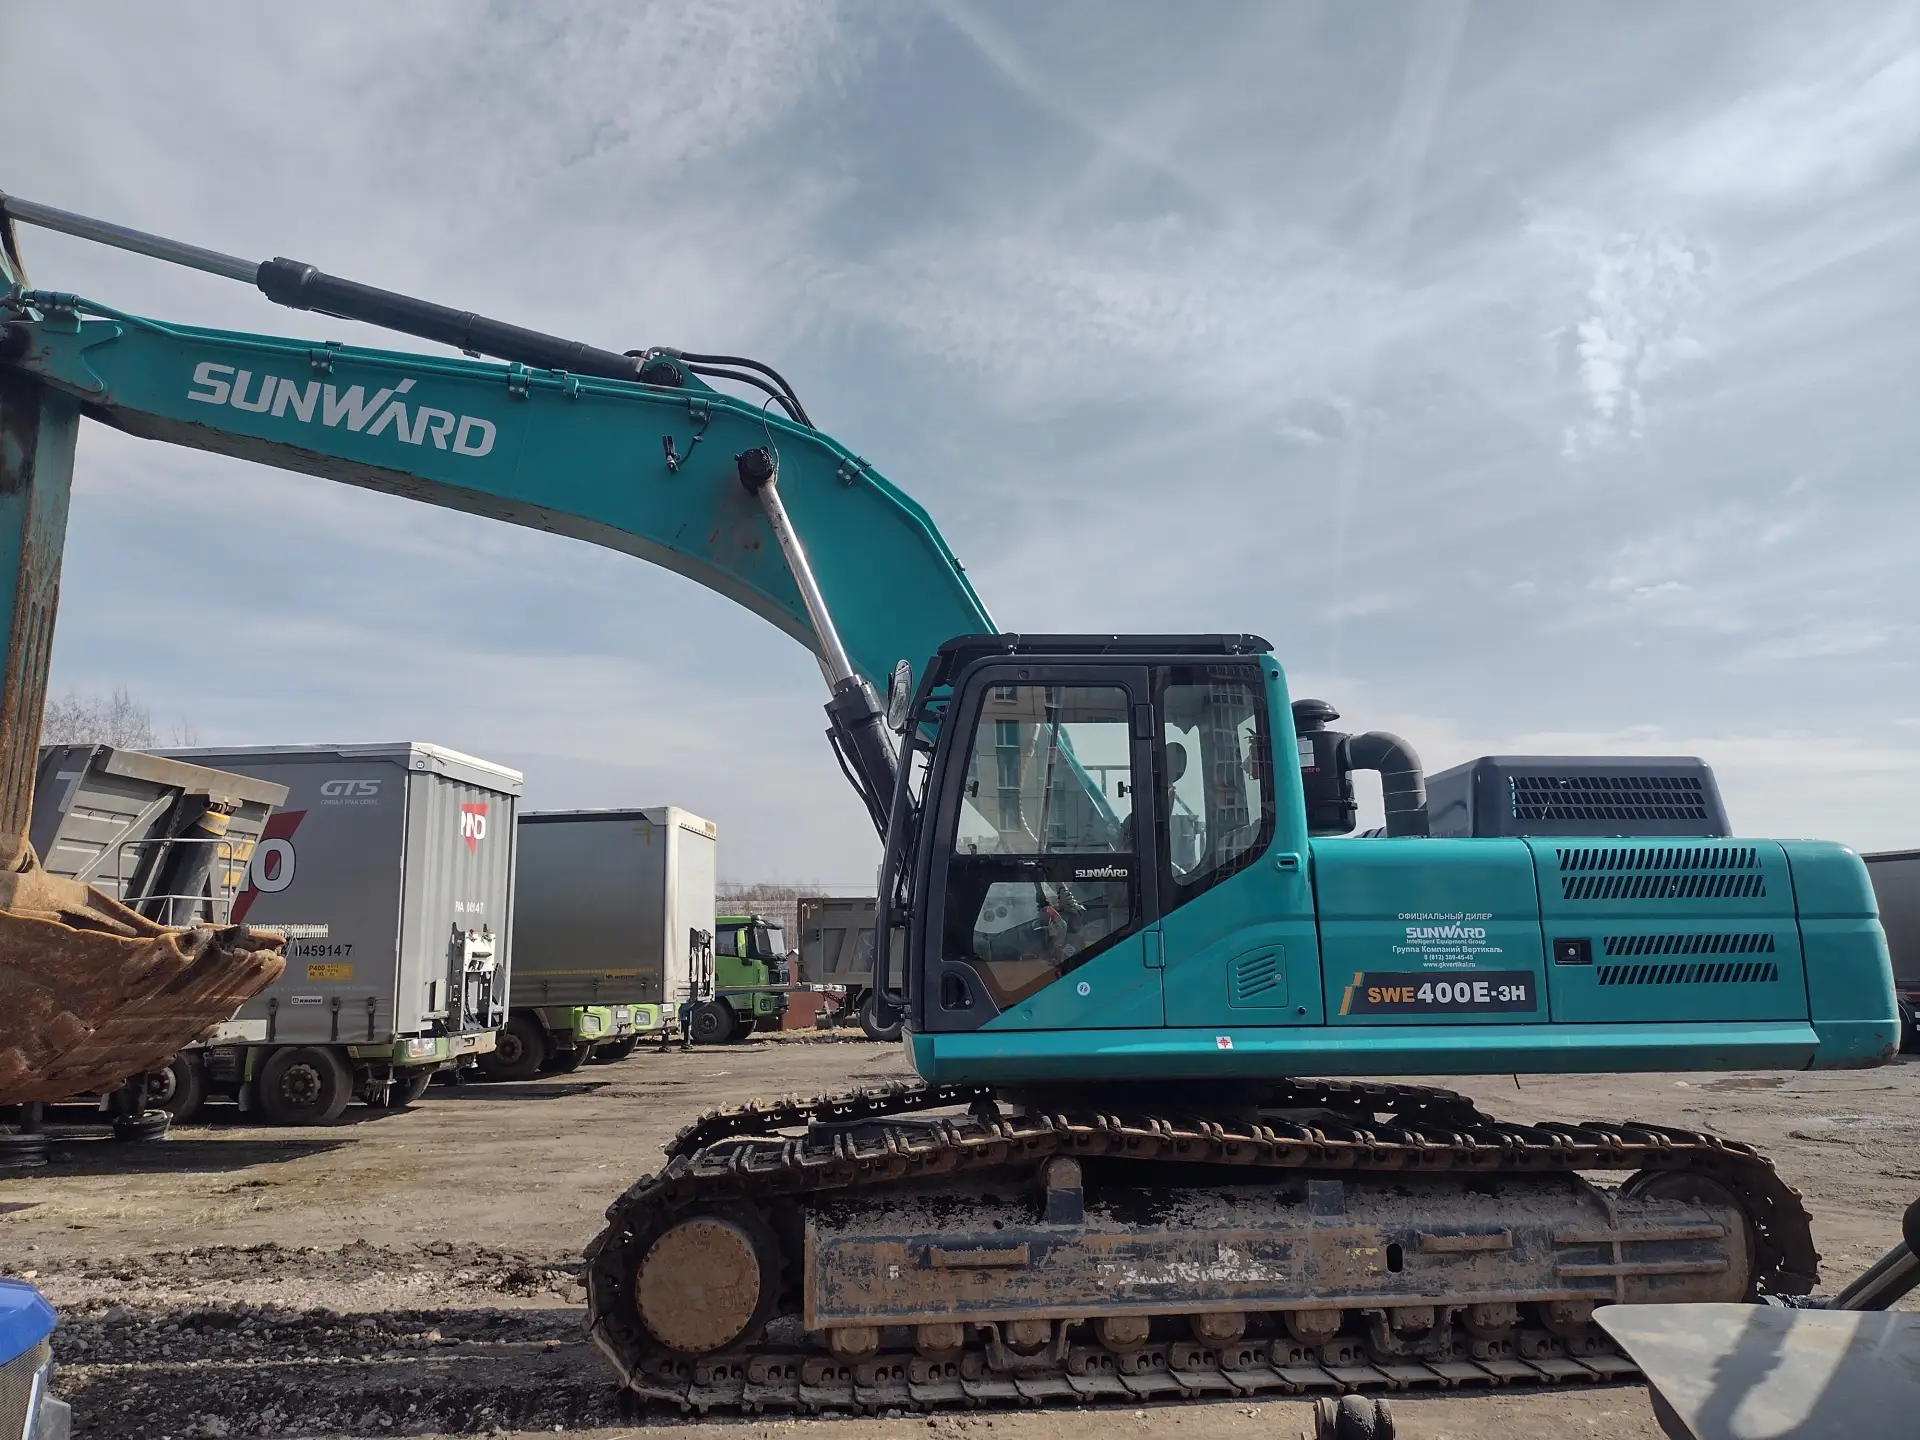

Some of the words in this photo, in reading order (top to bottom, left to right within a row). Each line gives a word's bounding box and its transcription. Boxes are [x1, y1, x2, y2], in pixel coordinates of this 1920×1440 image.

[187, 361, 497, 457] SUNWARD
[320, 779, 382, 796] GTS
[1075, 864, 1128, 878] SUNWARD
[1398, 911, 1463, 920] ОФИЦИАЛЬНЫЙ
[1465, 913, 1493, 921] ДИЛЕР
[1406, 921, 1486, 938] SUNWARD
[1392, 946, 1420, 954] Группа
[1421, 945, 1461, 953] Компаний
